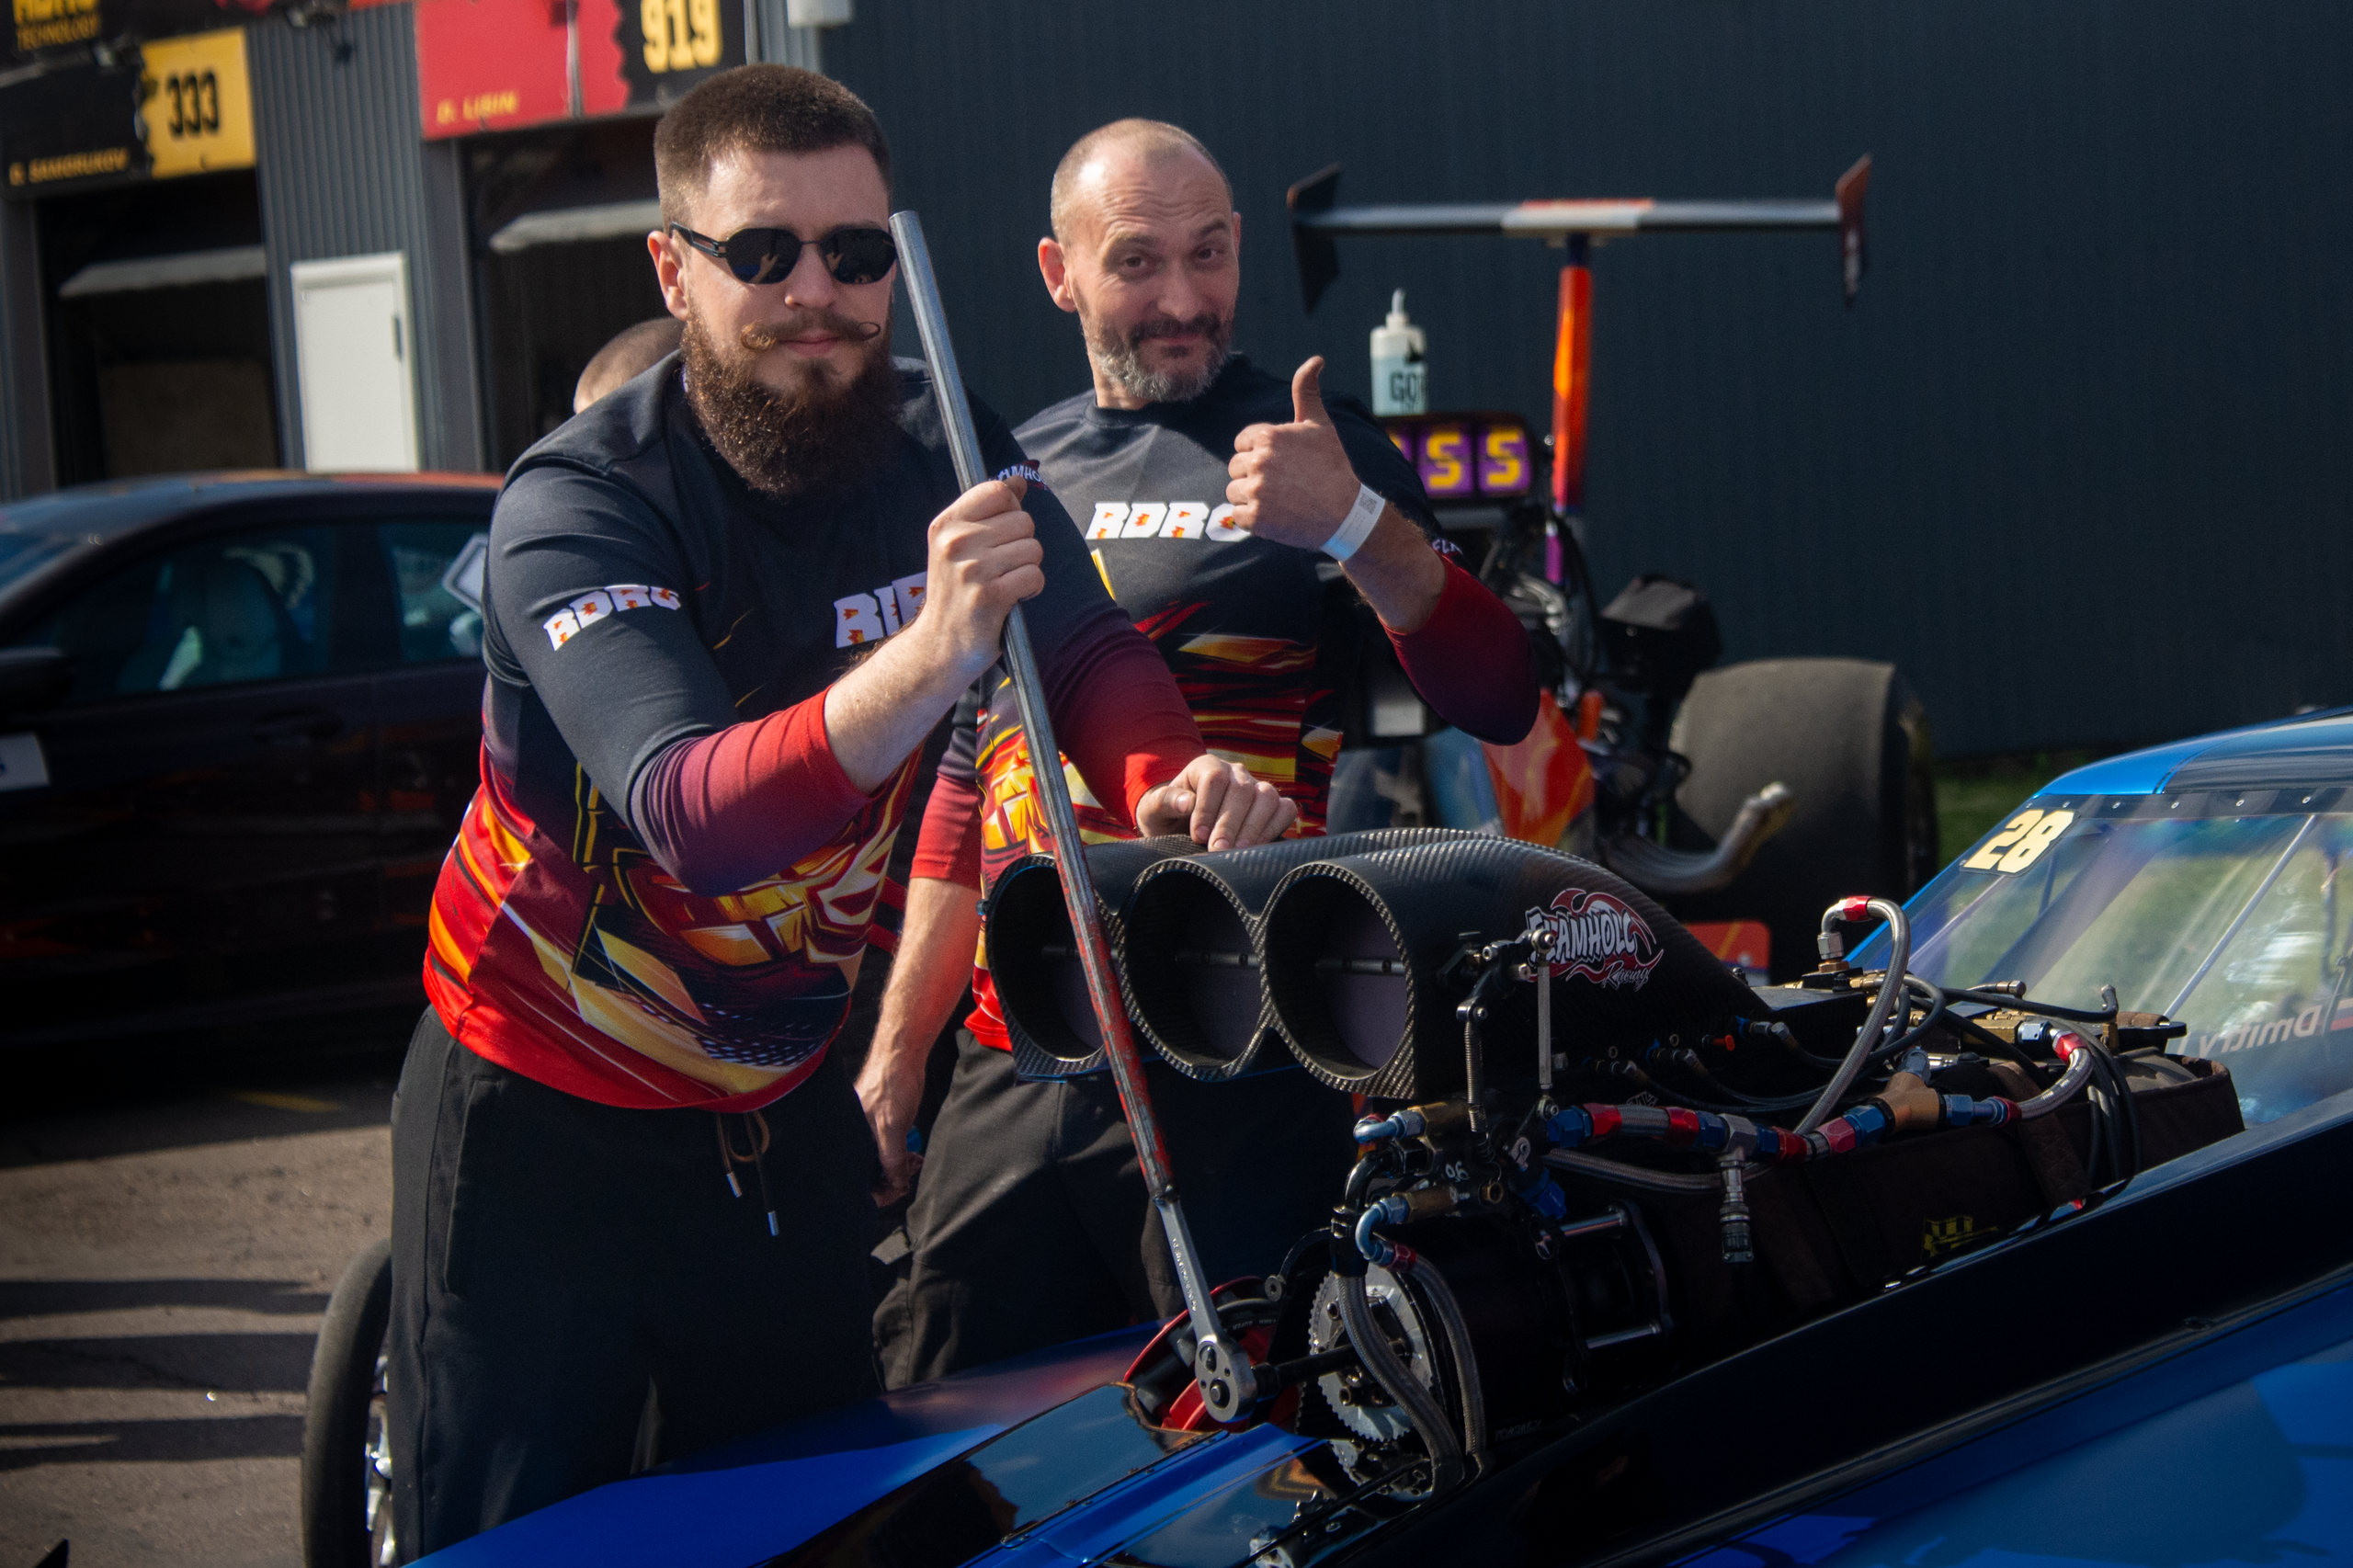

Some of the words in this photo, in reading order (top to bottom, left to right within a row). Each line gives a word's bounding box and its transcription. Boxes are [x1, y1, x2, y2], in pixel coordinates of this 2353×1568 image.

[641, 0, 722, 74] 919
[167, 70, 221, 138] 333
[1963, 809, 2075, 873] 28
[1601, 960, 1652, 992] Racing
